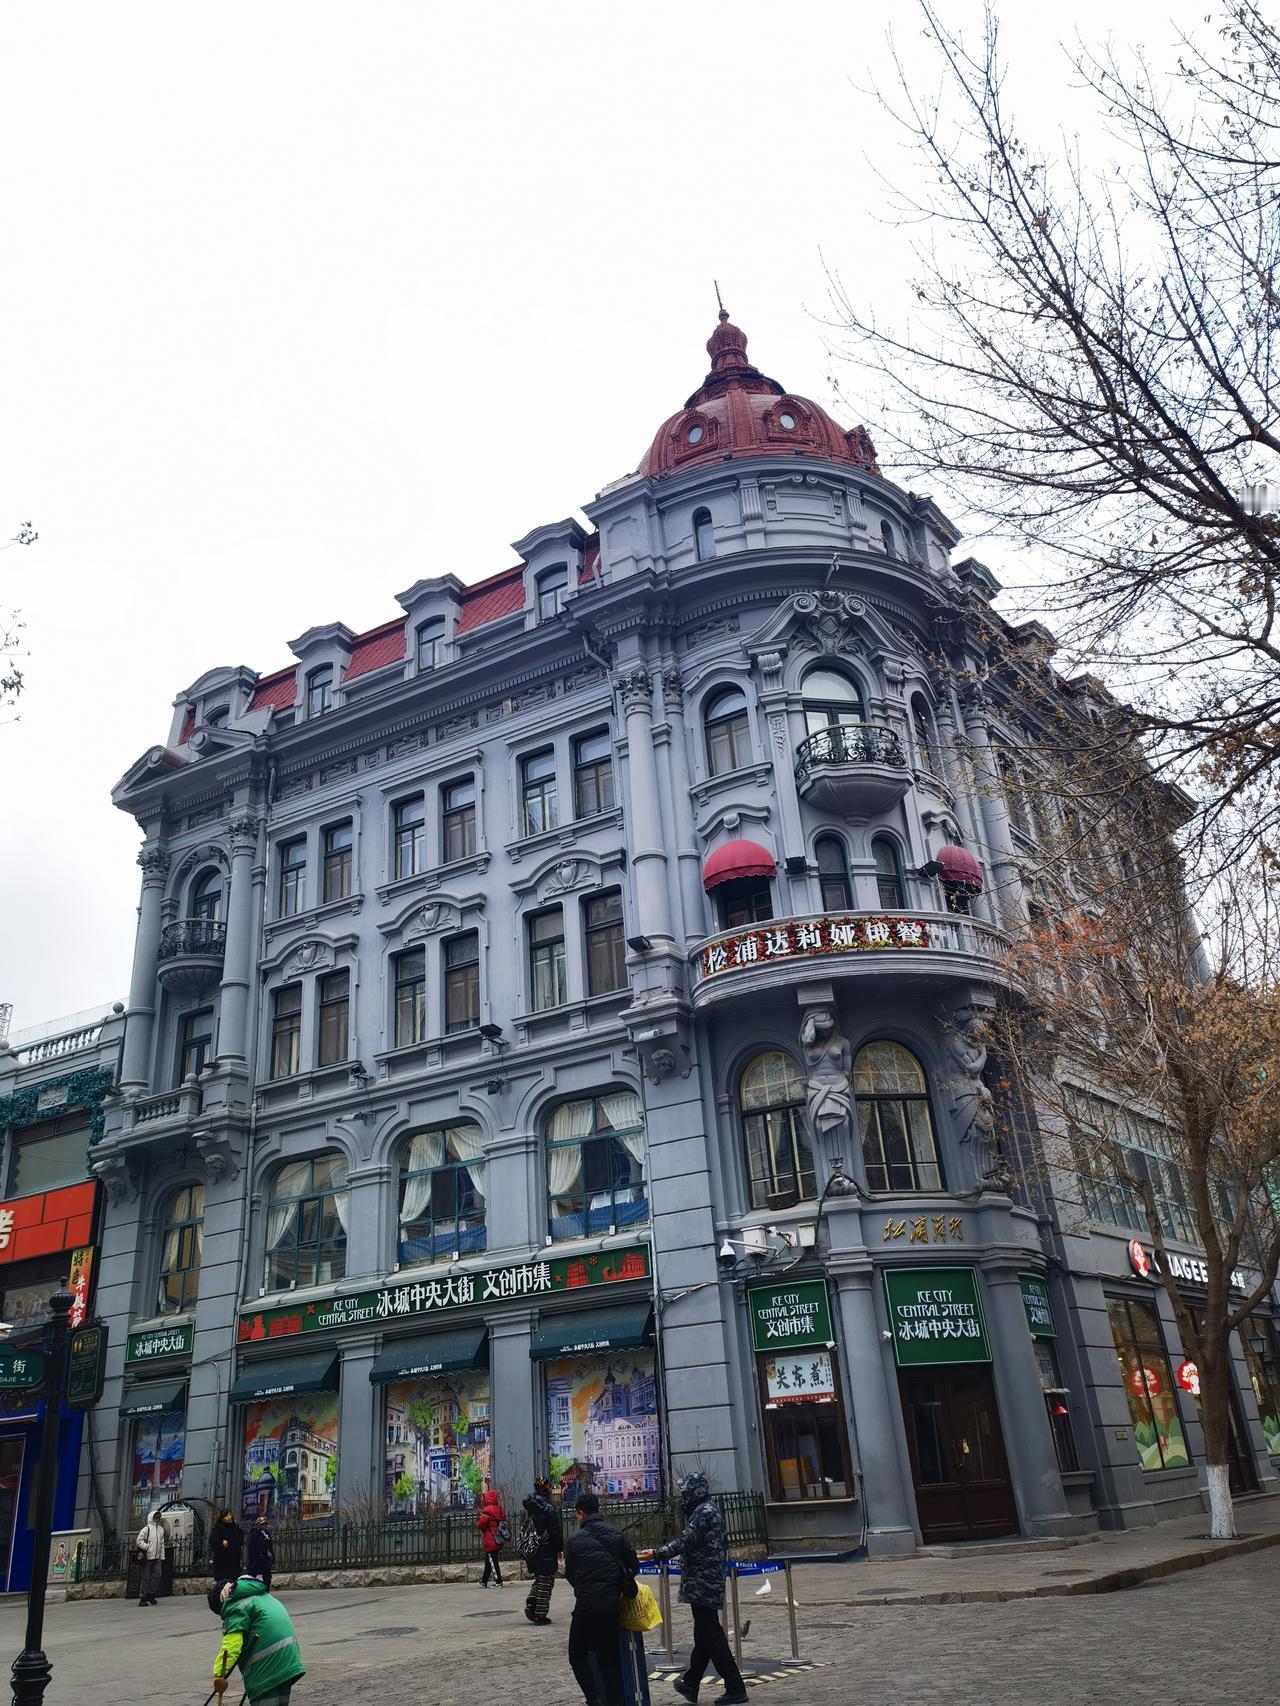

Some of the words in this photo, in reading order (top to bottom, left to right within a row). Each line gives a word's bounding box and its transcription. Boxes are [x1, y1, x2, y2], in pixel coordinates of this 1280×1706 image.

[376, 1275, 475, 1317] 冰城中央大街
[482, 1262, 552, 1300] 文创市集
[917, 1290, 932, 1303] ICE
[933, 1290, 952, 1303] CITY
[333, 1300, 344, 1311] ICE
[345, 1298, 359, 1309] CITY
[771, 1296, 783, 1307] ICE
[784, 1293, 799, 1305] CITY
[318, 1311, 348, 1326] CENTRAL
[348, 1306, 375, 1322] STREET
[757, 1306, 789, 1320] CENTRAL
[789, 1302, 819, 1316] STREET
[897, 1304, 940, 1318] CENTRAL
[941, 1303, 974, 1317] STREET
[766, 1315, 815, 1338] 文创市集
[898, 1319, 981, 1341] 冰城中央大街
[135, 1334, 185, 1357] 冰城中央大街
[776, 1362, 824, 1390] 关东煮
